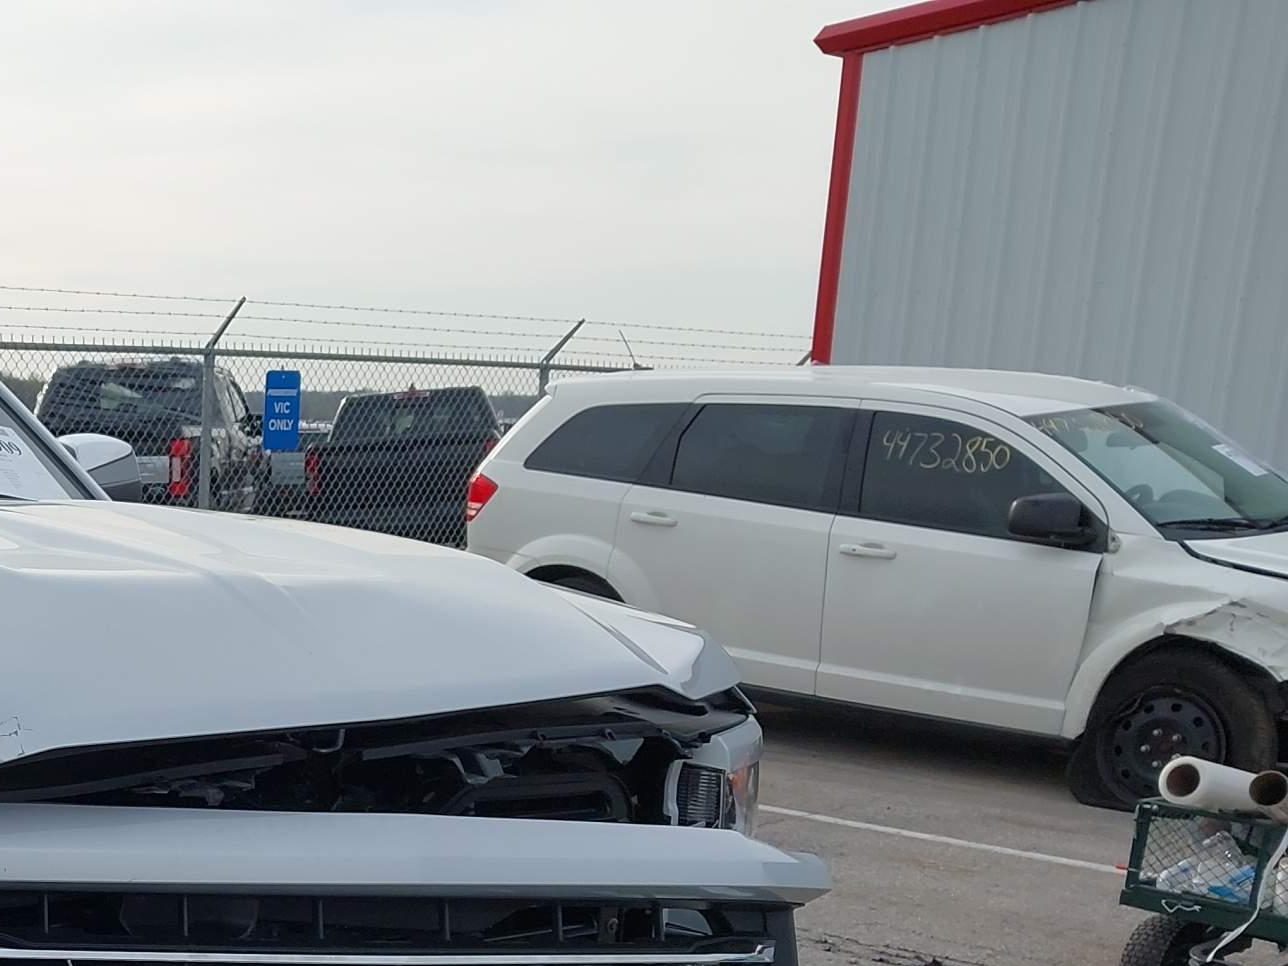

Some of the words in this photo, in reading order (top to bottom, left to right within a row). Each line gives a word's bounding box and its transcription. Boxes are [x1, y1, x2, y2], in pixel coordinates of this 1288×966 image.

[273, 401, 291, 414] VIC
[268, 418, 294, 431] ONLY
[883, 426, 1011, 473] 44732850
